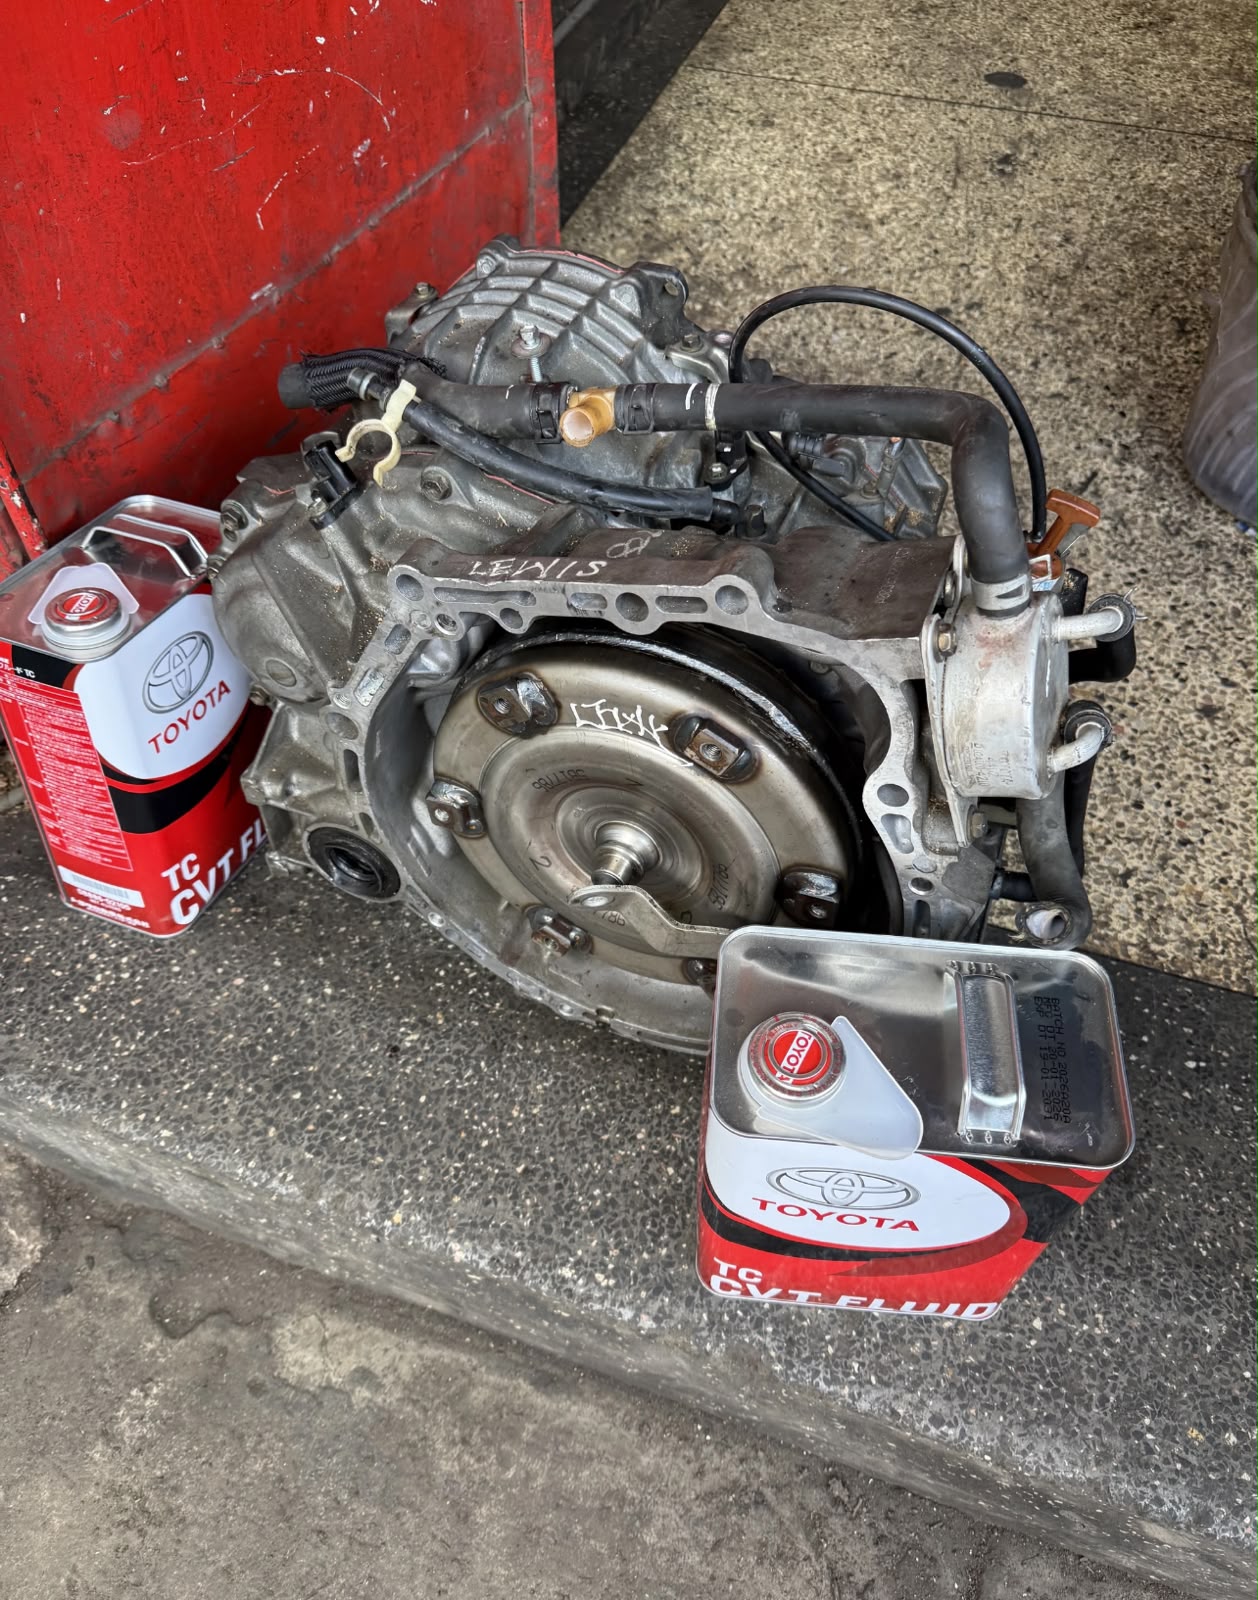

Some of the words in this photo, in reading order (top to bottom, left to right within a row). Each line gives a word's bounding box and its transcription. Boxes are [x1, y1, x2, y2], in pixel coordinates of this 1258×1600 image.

[148, 680, 232, 754] TOYOTA
[161, 853, 200, 891] TC
[170, 848, 235, 925] CVT
[1033, 996, 1044, 1019] EXP
[1051, 997, 1065, 1035] BATCH
[1037, 1024, 1047, 1041] DT
[752, 1197, 920, 1232] TOYOTA
[713, 1257, 763, 1283] TC
[709, 1275, 822, 1301] CVT
[835, 1296, 999, 1317] FLUID
